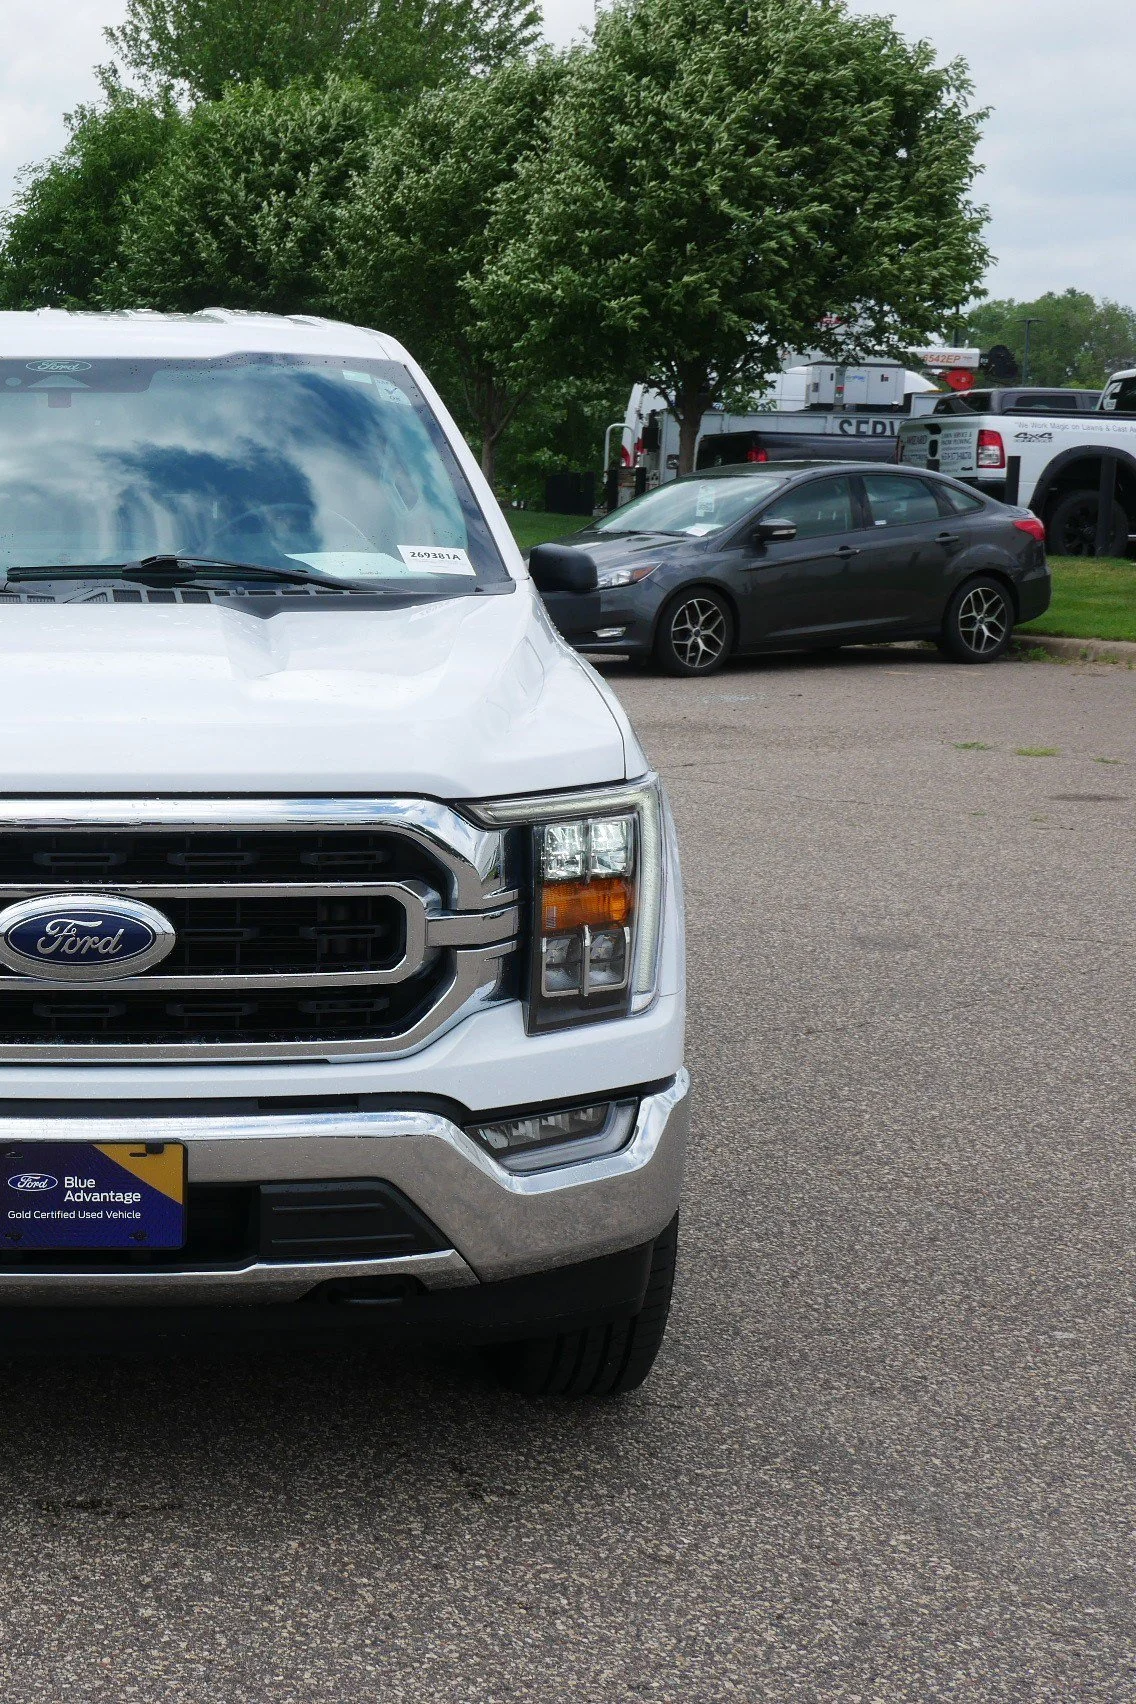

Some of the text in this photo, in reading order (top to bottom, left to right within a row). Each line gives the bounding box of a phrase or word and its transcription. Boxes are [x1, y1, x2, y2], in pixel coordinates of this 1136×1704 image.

[409, 551, 461, 561] 269381A
[37, 918, 125, 954] Ford
[64, 1176, 96, 1188] Blue
[64, 1190, 141, 1204] Advantage
[7, 1210, 141, 1219] Gold Certified Used Vehicle
